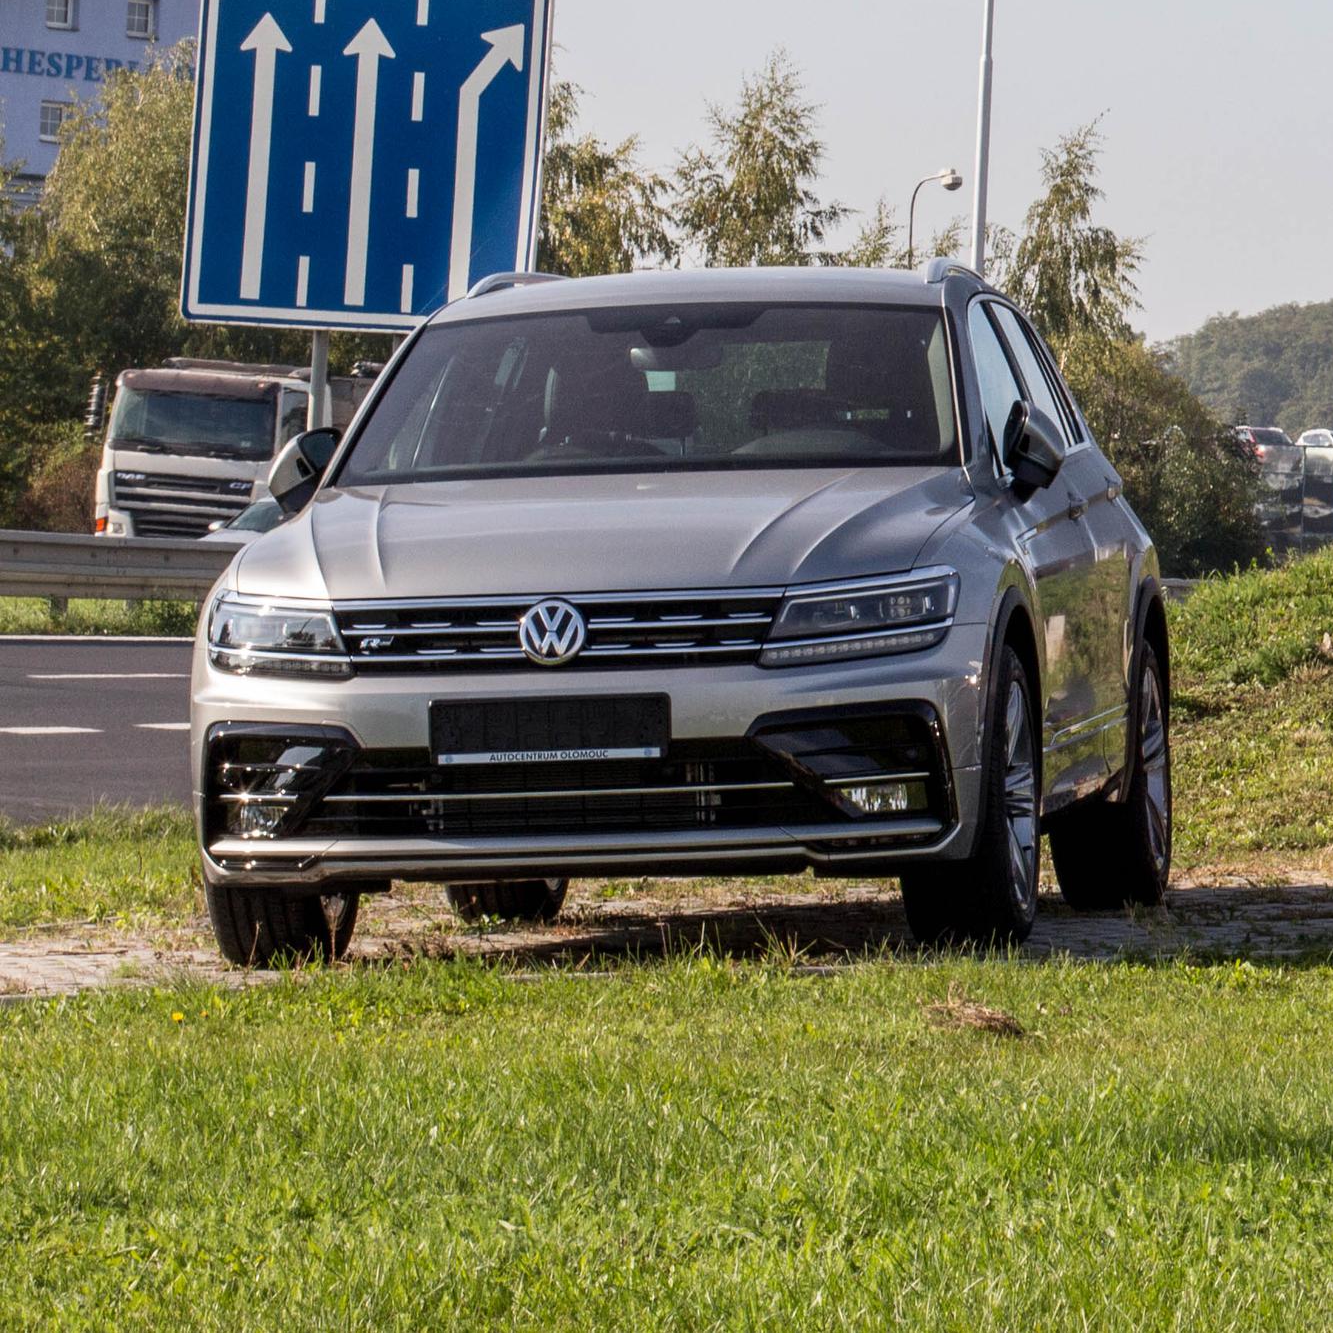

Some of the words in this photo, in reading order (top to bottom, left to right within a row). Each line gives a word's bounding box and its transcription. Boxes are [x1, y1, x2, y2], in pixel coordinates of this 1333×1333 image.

[520, 599, 584, 663] VW
[489, 751, 558, 762] AUTOCENTRUM
[560, 749, 609, 759] OLOMOUC
